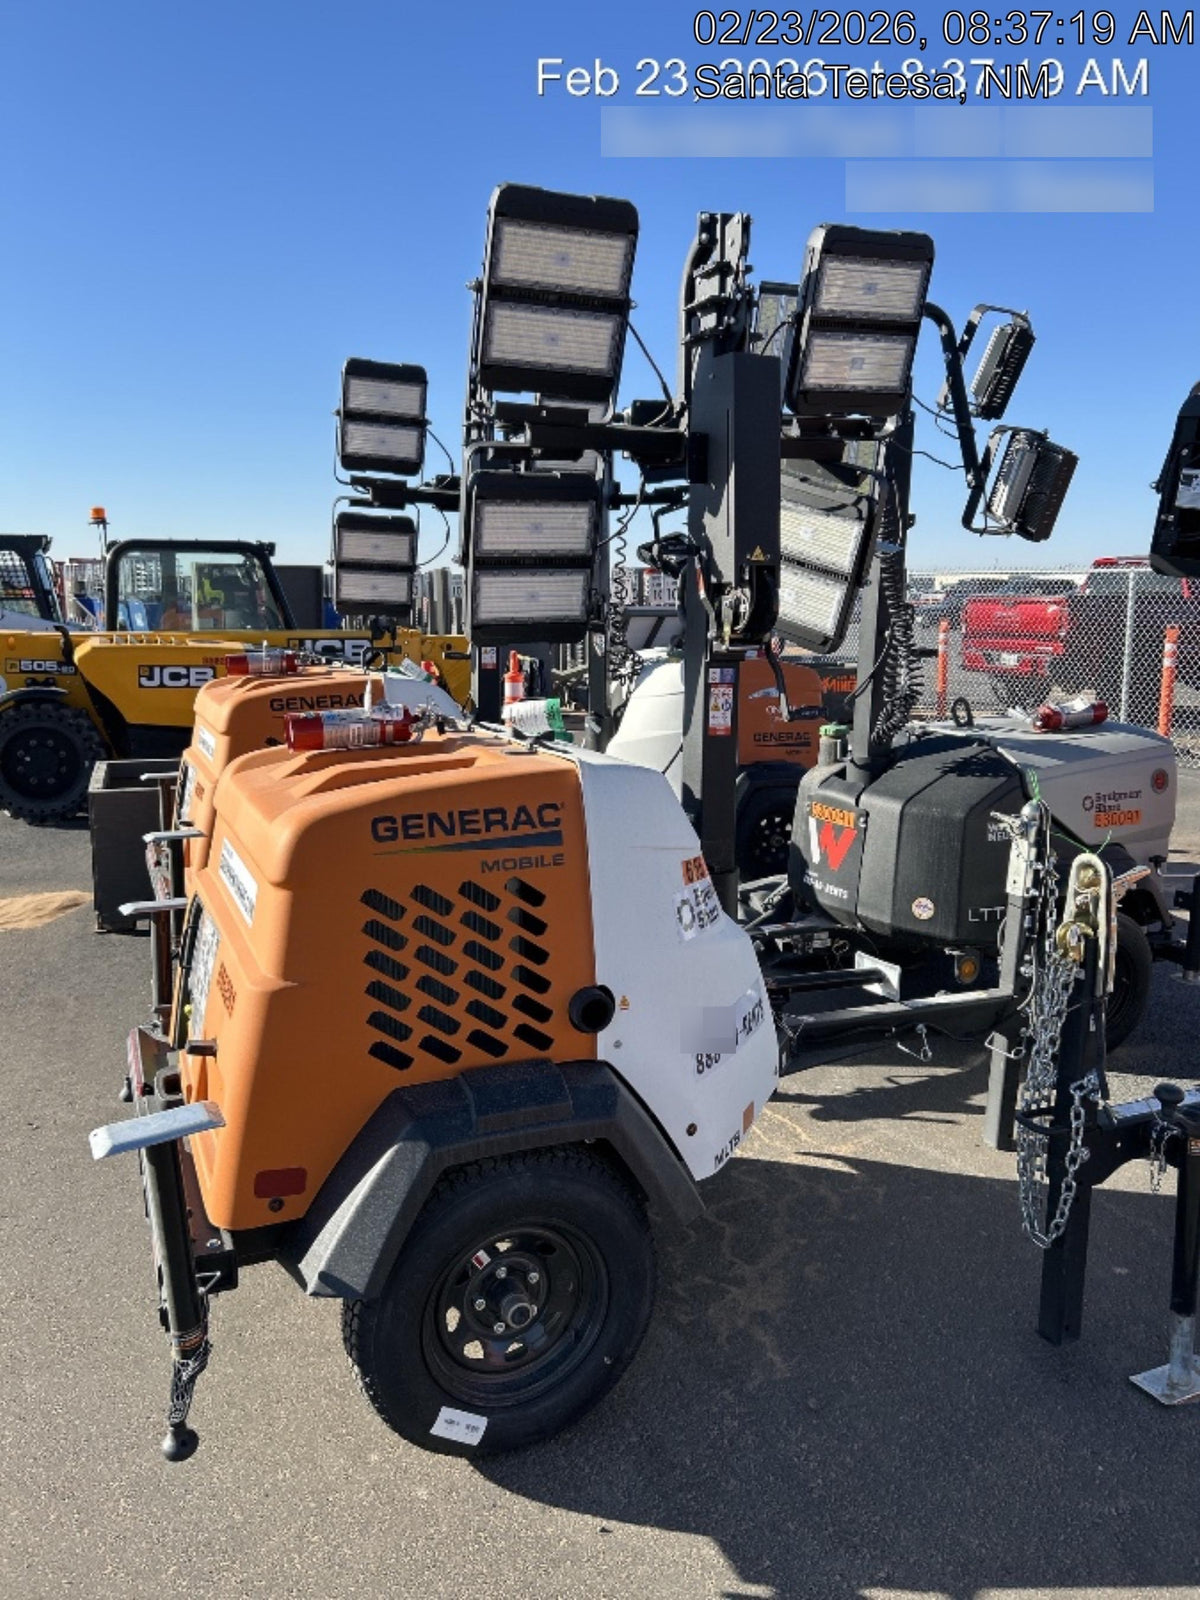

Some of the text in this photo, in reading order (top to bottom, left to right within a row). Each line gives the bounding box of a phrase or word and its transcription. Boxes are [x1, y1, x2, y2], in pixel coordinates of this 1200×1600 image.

[139, 666, 214, 688] JCB
[753, 732, 812, 743] GENERAC
[371, 803, 561, 843] GENERAC
[481, 853, 566, 874] MOBILE
